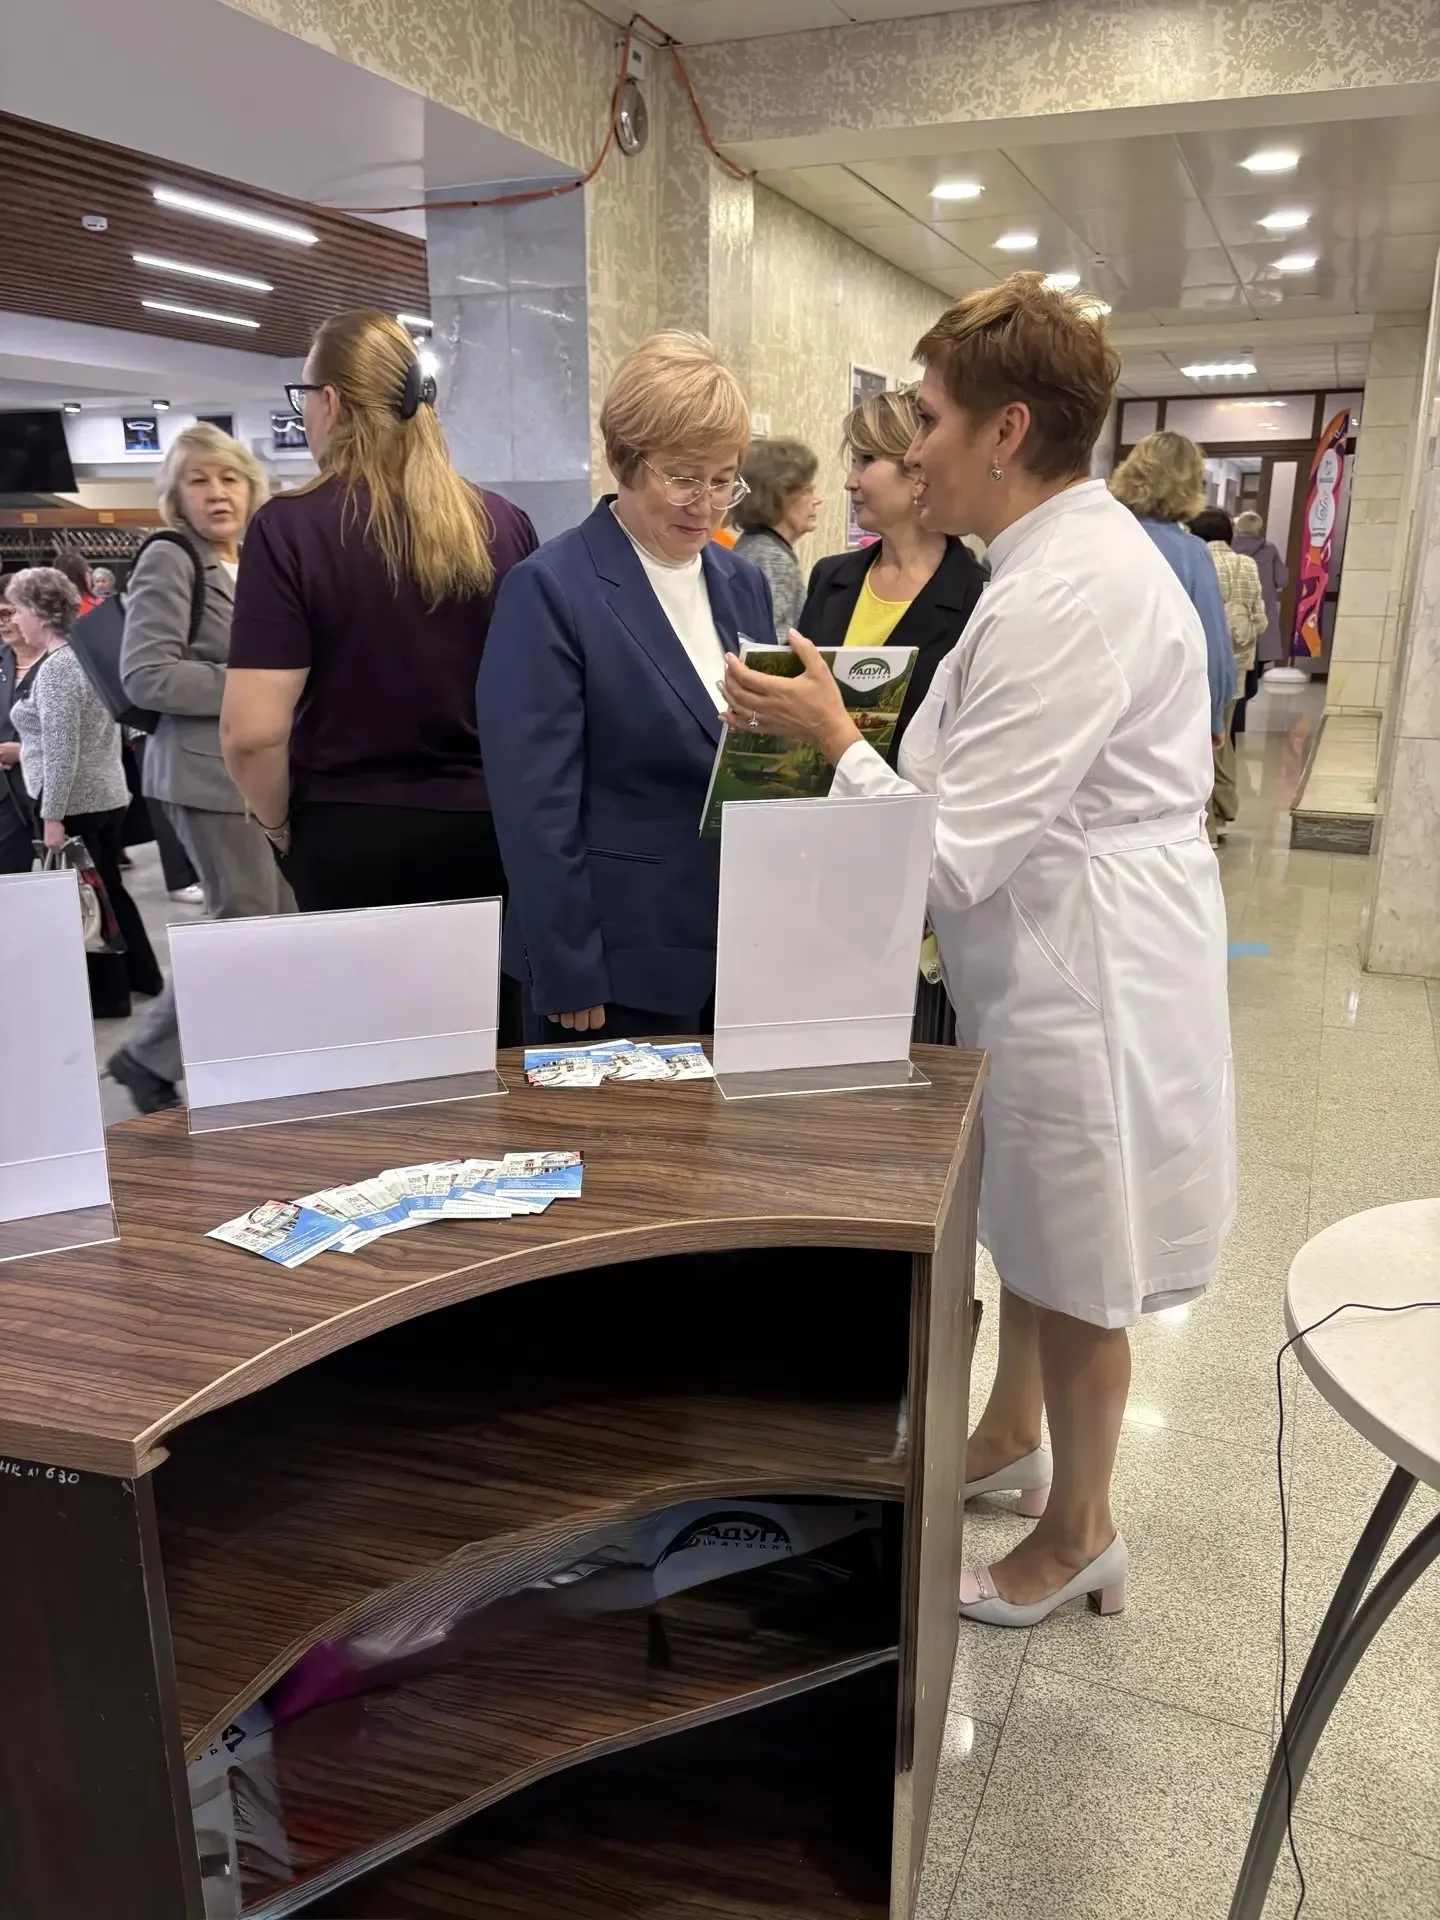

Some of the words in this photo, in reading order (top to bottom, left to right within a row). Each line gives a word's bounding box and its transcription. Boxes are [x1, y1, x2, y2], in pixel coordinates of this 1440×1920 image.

[848, 667, 891, 676] РАДУГА
[45, 1467, 80, 1485] 630
[706, 1526, 791, 1544] АДУГА
